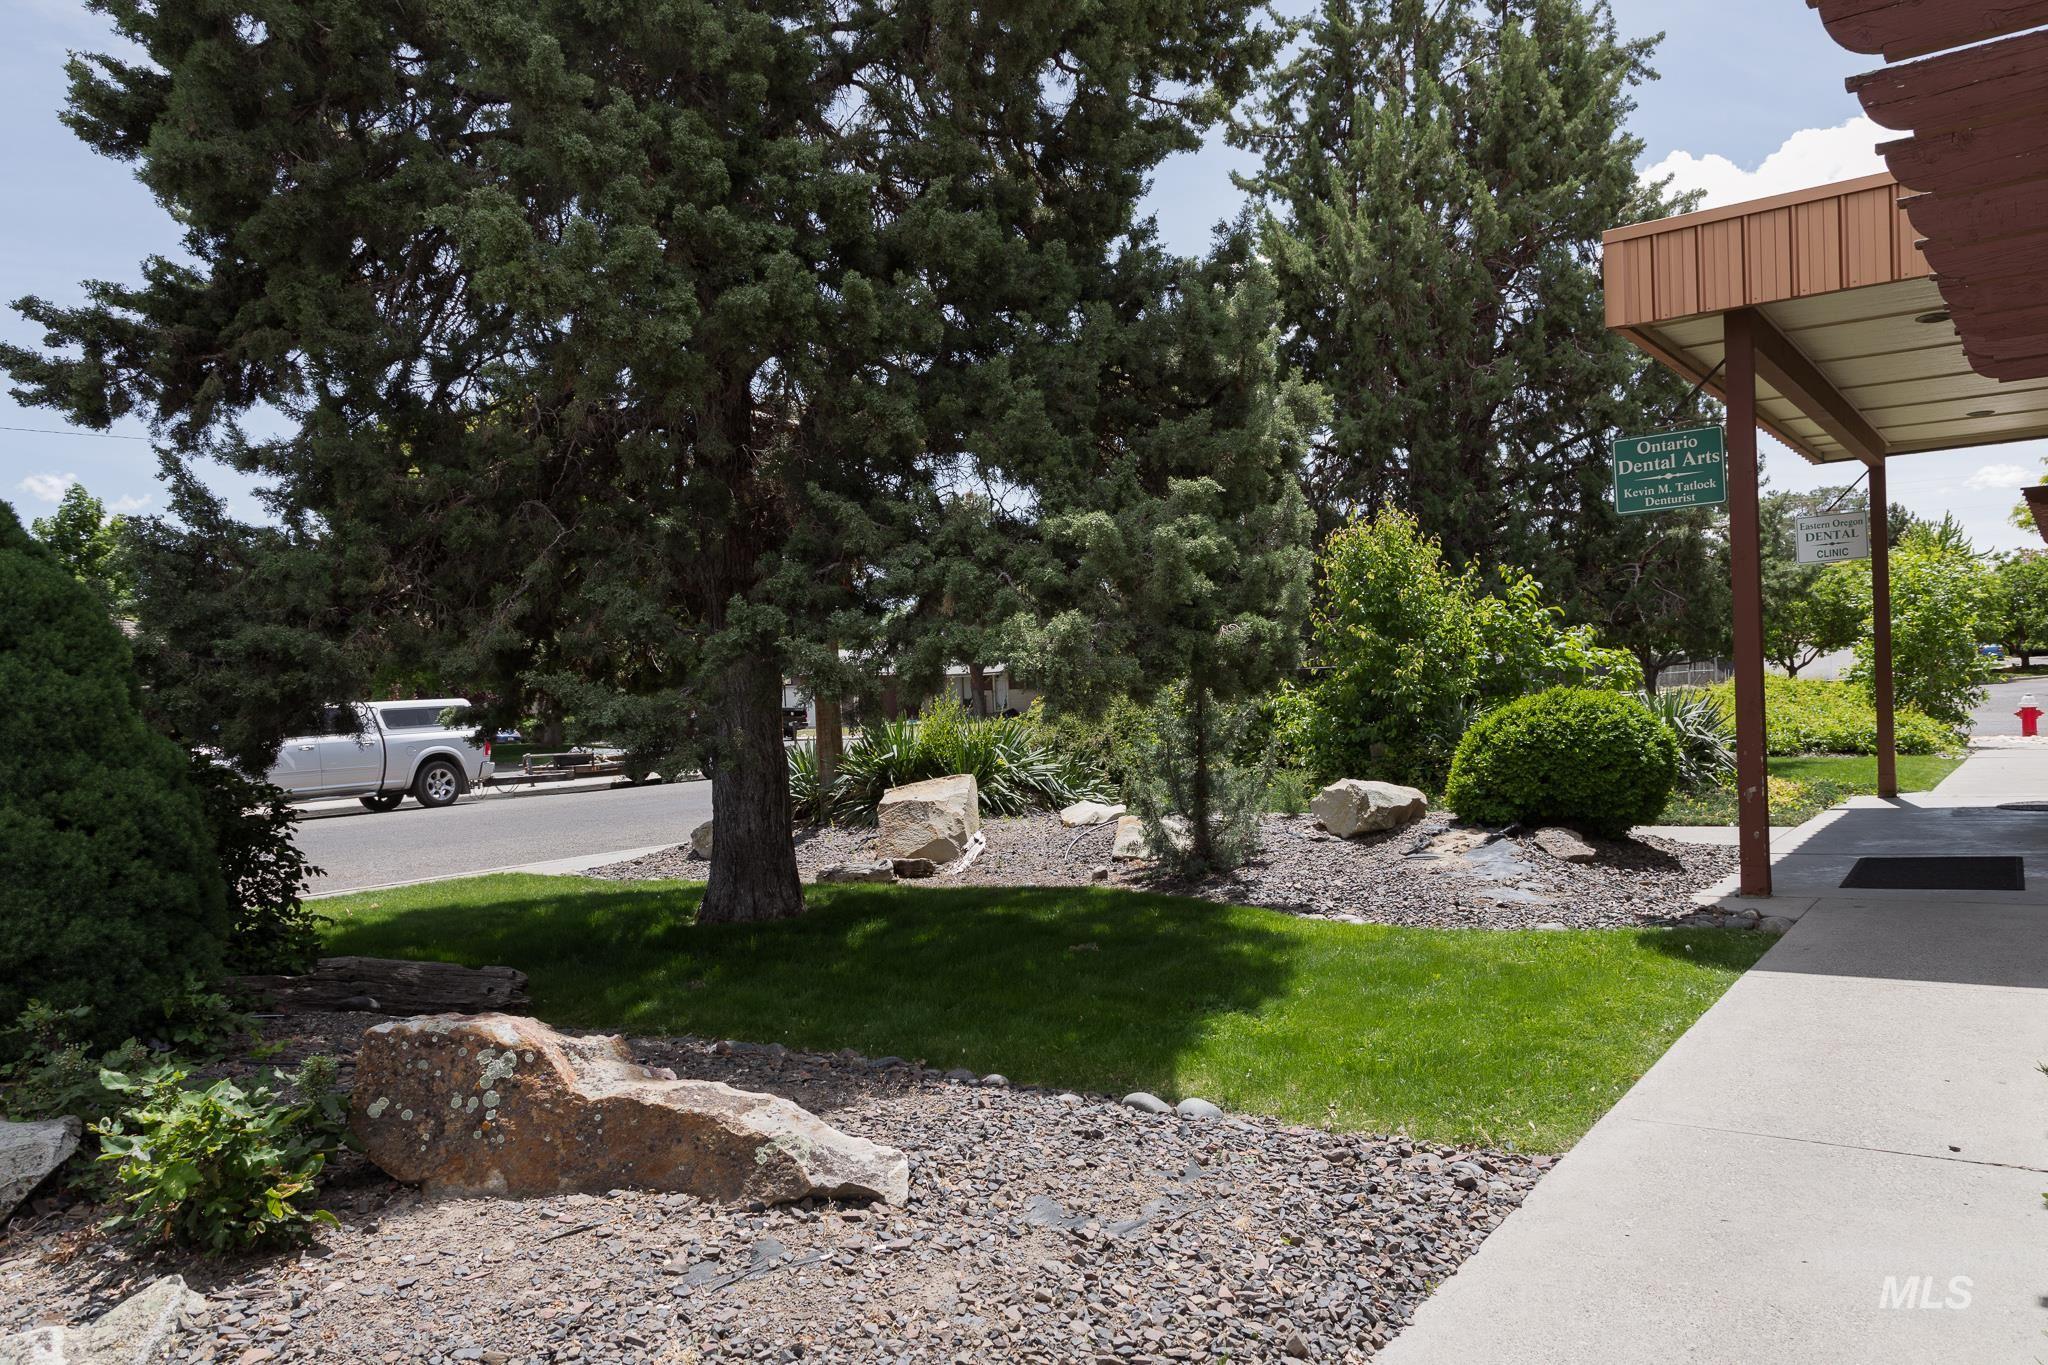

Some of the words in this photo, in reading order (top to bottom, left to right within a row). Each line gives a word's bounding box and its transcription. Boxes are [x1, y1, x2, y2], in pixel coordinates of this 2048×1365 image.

[1637, 436, 1698, 454] Ontario
[1618, 453, 1676, 475] Dental
[1682, 451, 1720, 467] Arts
[1624, 486, 1655, 498] Kevin
[1658, 484, 1672, 494] M.
[1675, 478, 1717, 492] Tatlock
[1645, 493, 1696, 507] Denturist
[1800, 522, 1830, 531] Eastern
[1832, 519, 1863, 528] Oregon
[1806, 529, 1859, 542] DENTAL
[1816, 547, 1849, 558] CLINIC
